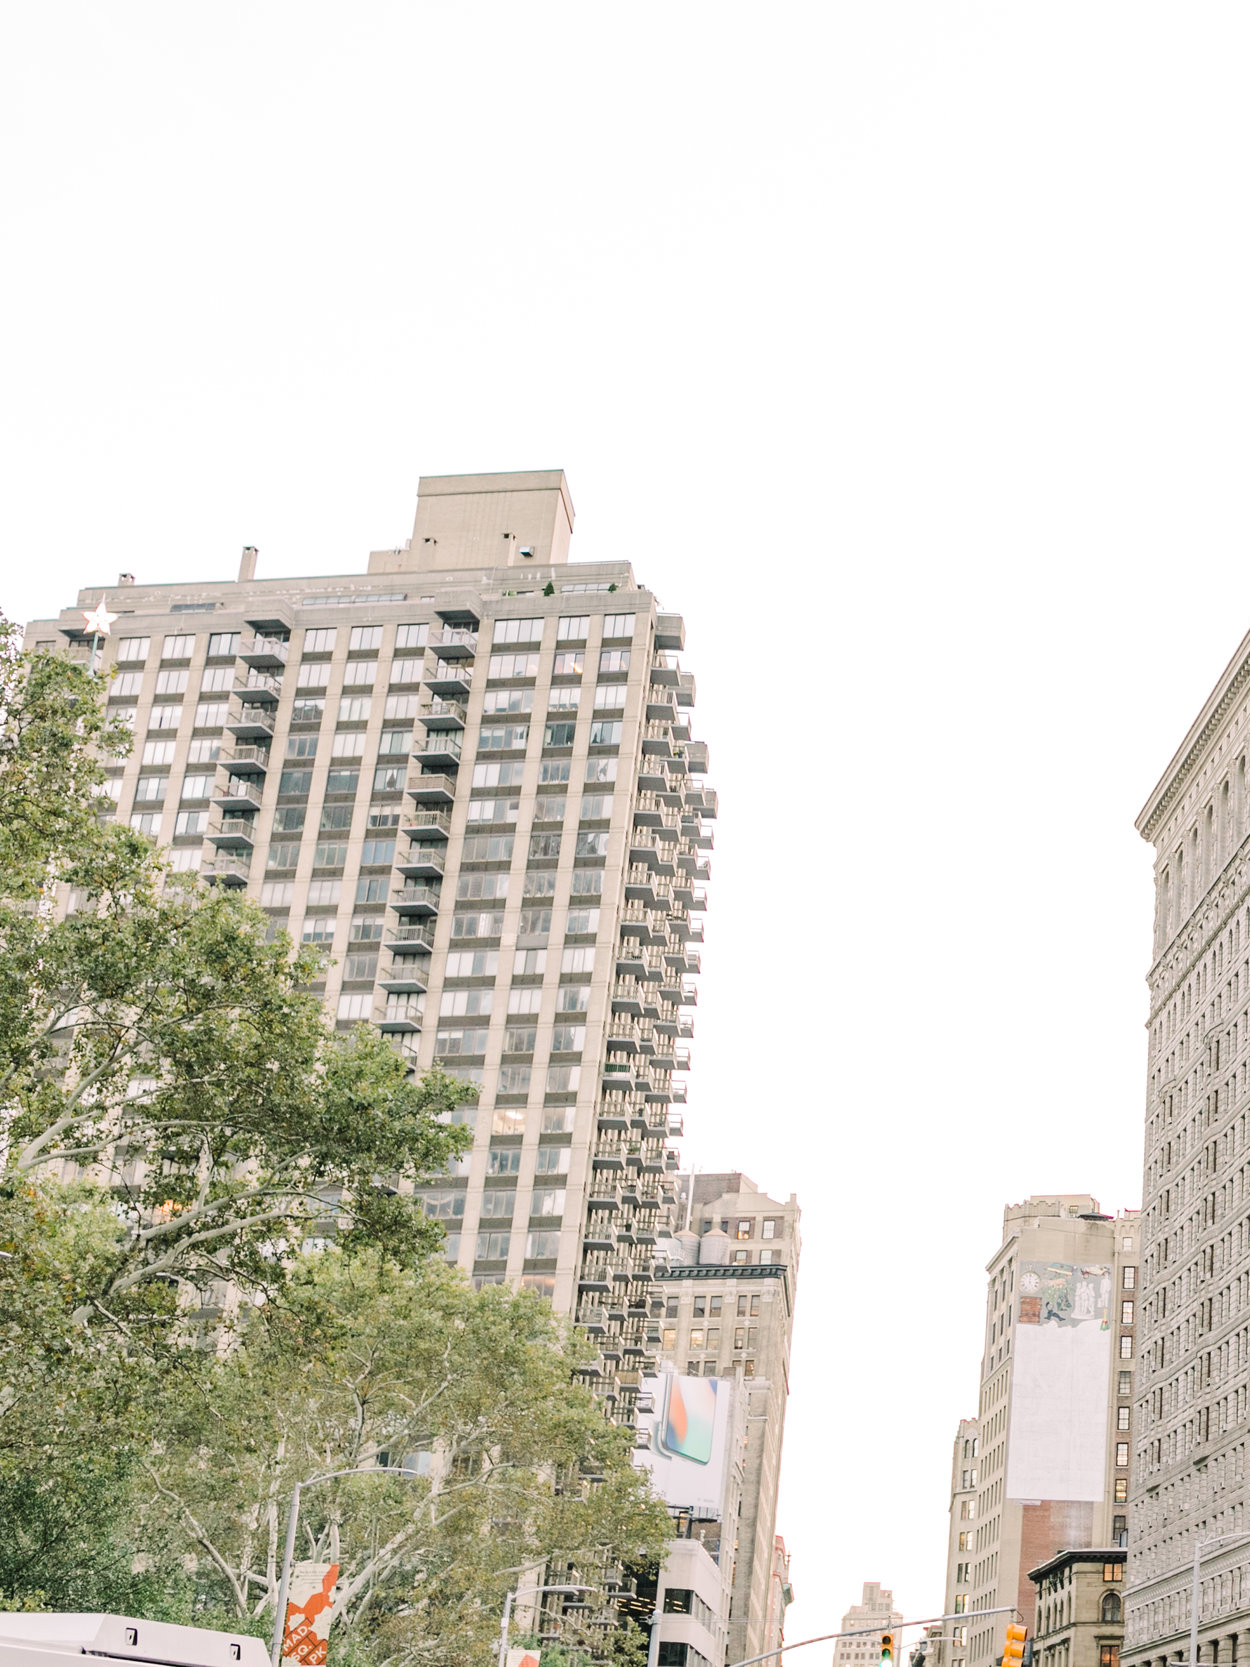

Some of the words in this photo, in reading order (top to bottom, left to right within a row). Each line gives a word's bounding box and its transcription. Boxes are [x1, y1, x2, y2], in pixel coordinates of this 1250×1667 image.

[283, 1626, 311, 1652] MAD.
[291, 1645, 312, 1662] SQ.
[309, 1646, 327, 1665] PK
